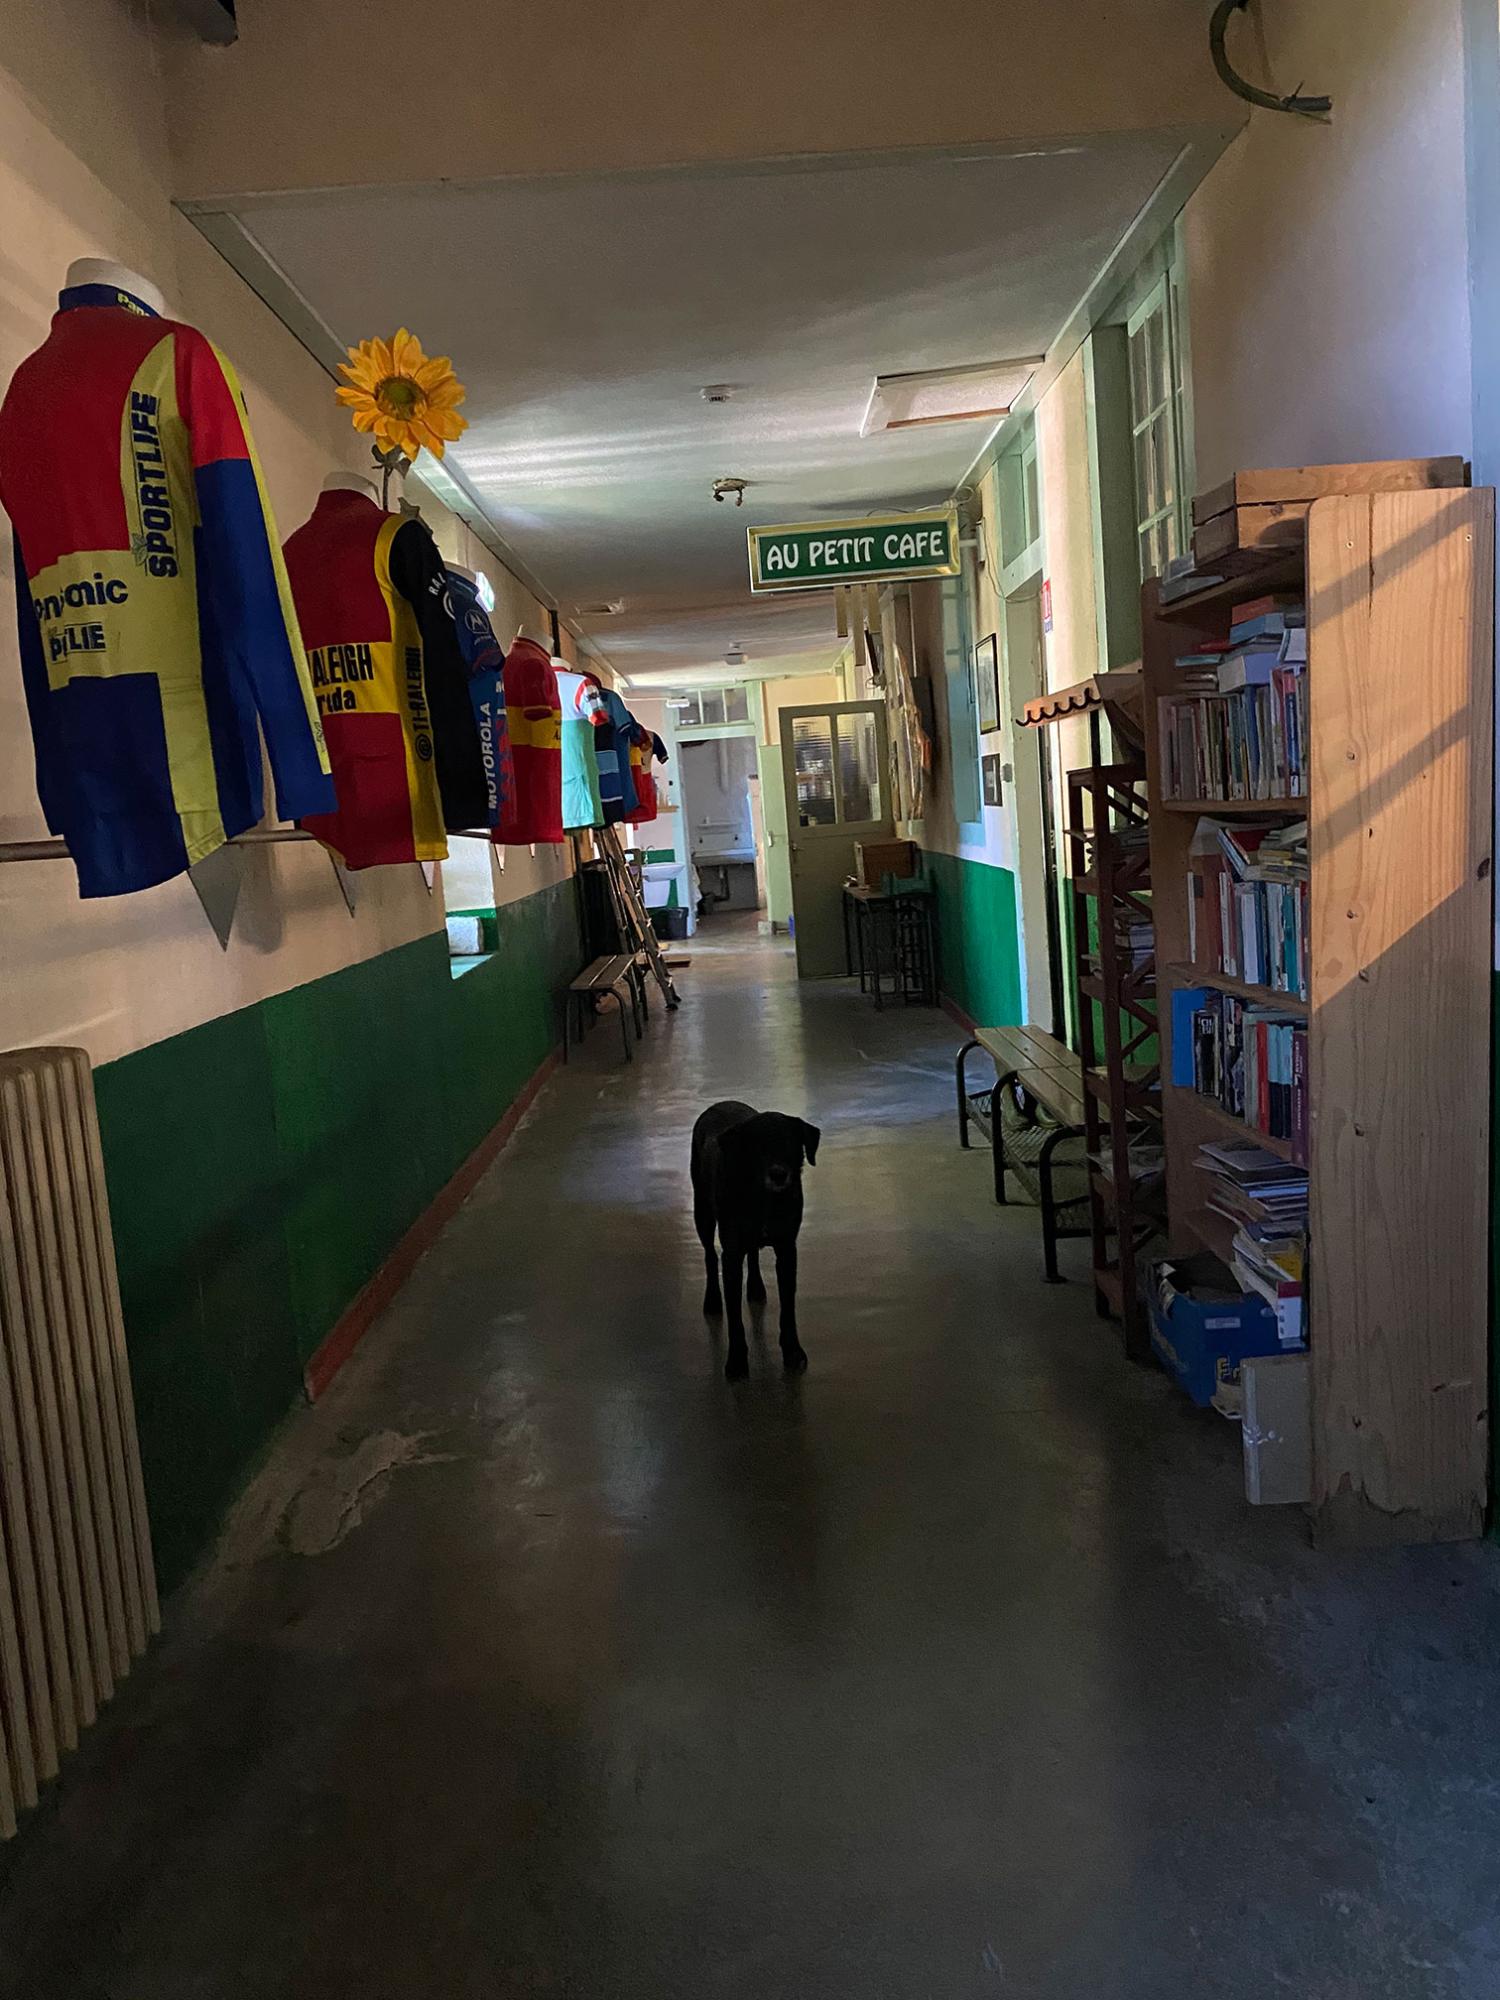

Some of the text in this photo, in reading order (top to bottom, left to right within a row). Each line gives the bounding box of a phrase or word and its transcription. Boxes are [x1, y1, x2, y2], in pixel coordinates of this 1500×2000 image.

[131, 391, 178, 578] SPORTLIFE
[766, 530, 944, 571] AU PETIT CAFE
[307, 644, 374, 687] ALEIGH
[480, 702, 497, 809] MOTOROLA
